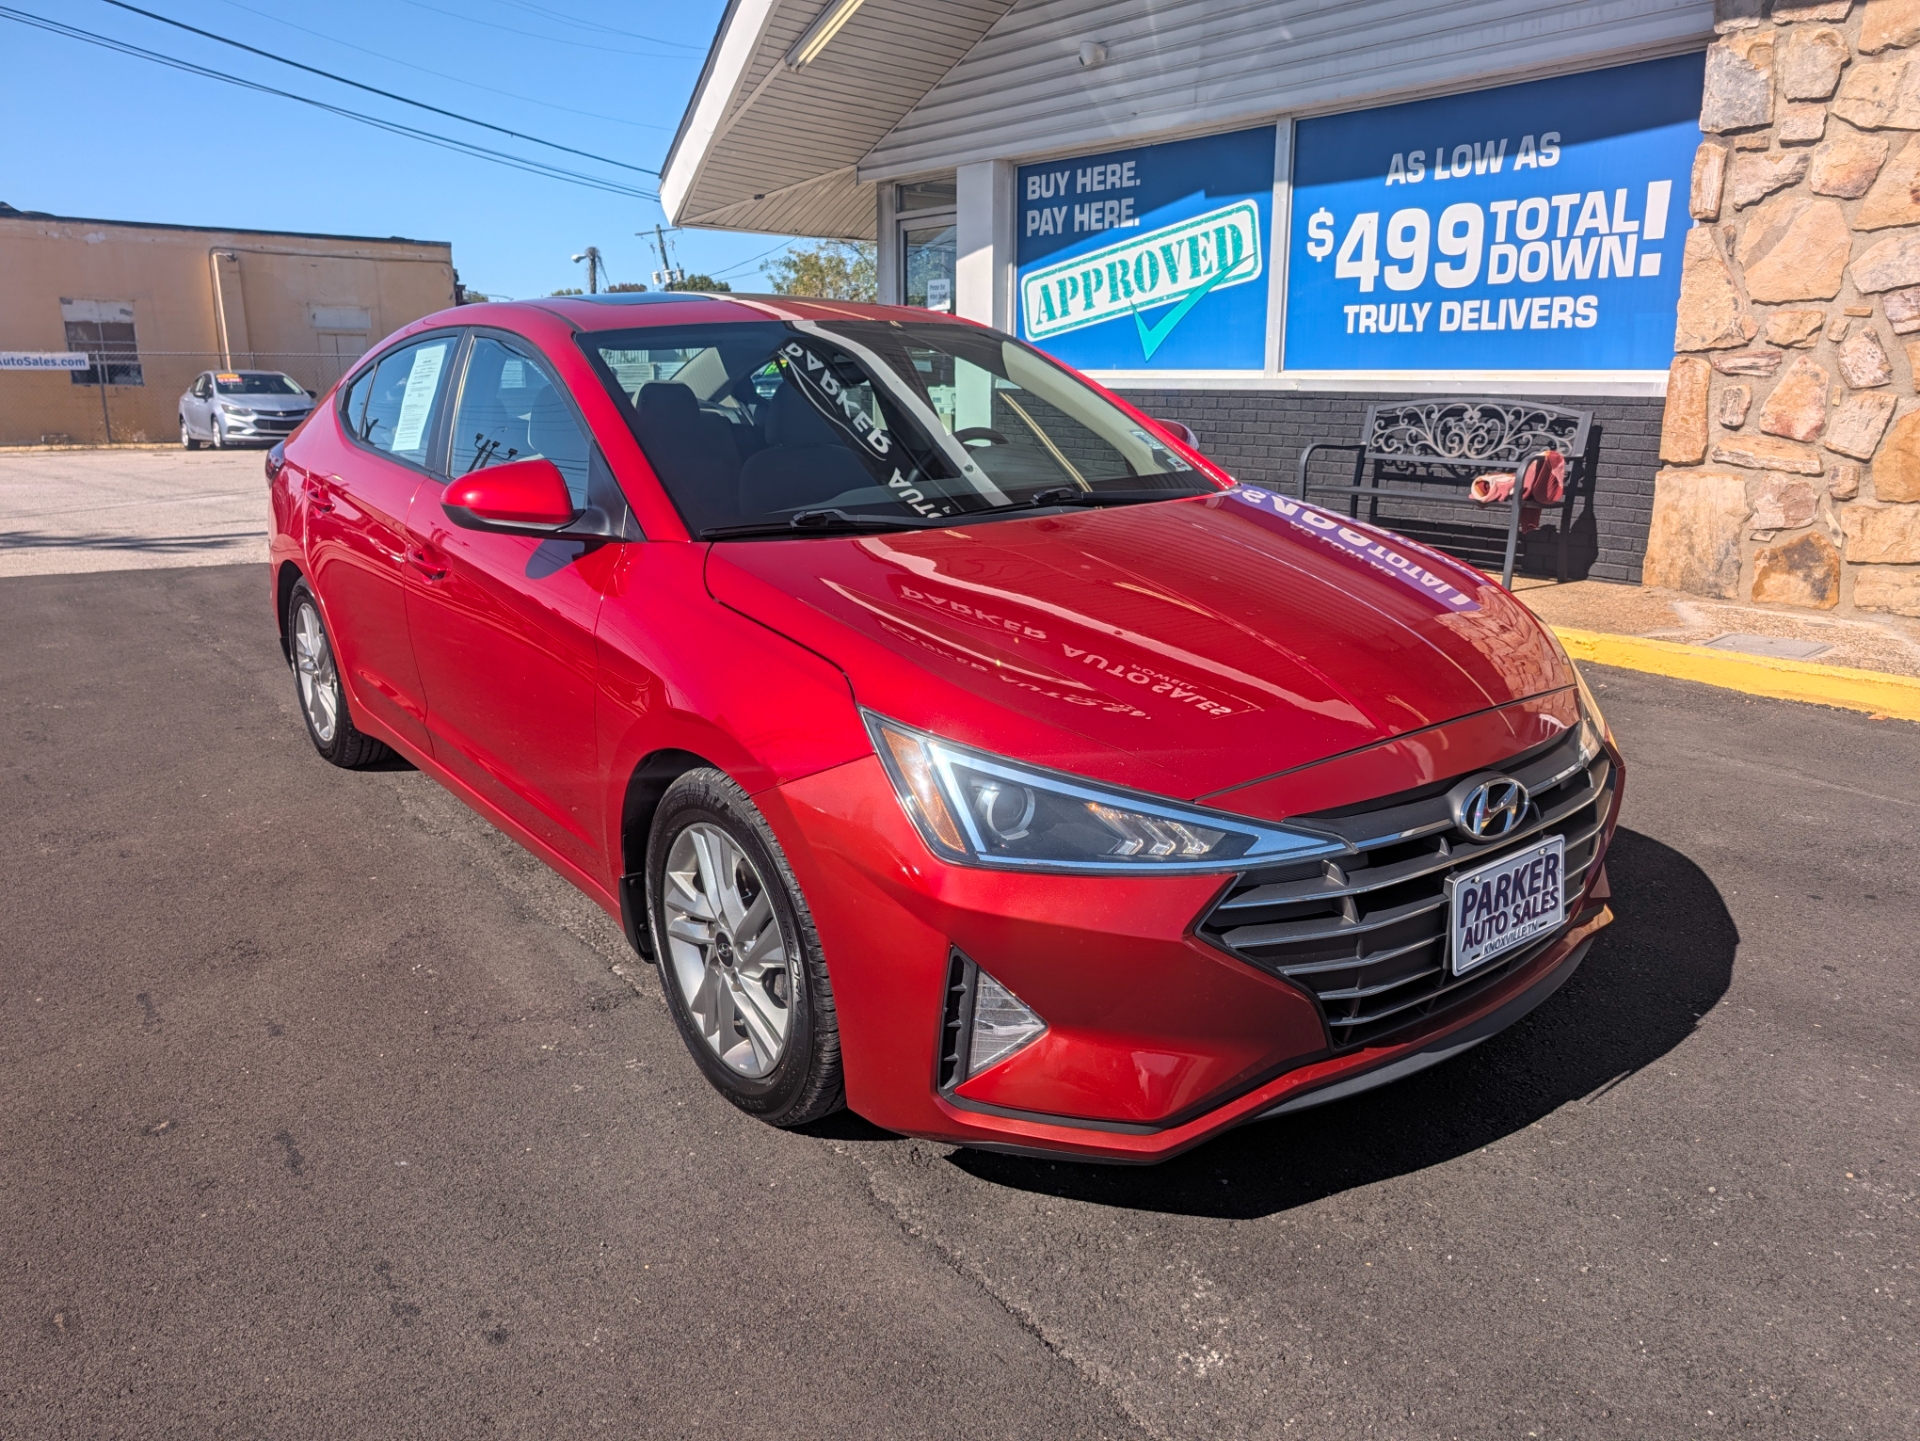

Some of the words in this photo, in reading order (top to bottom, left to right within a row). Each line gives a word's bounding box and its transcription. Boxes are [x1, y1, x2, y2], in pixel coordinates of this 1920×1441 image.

[1027, 171, 1070, 200] BUY
[1077, 161, 1141, 194] HERE.
[1385, 151, 1426, 187] AS
[1434, 139, 1508, 181] LOW
[1513, 132, 1561, 172] AS
[1026, 206, 1068, 237] PAY
[1074, 198, 1140, 232] HERE.
[1306, 203, 1485, 293] $499
[1490, 187, 1641, 244] TOTAL
[1035, 223, 1245, 326] APPROVED
[1343, 301, 1433, 334] TRULY
[1438, 295, 1599, 332] DELIVERS
[1460, 852, 1560, 929] PARKER
[1461, 910, 1508, 952] AUTO
[1511, 887, 1559, 928] SALES
